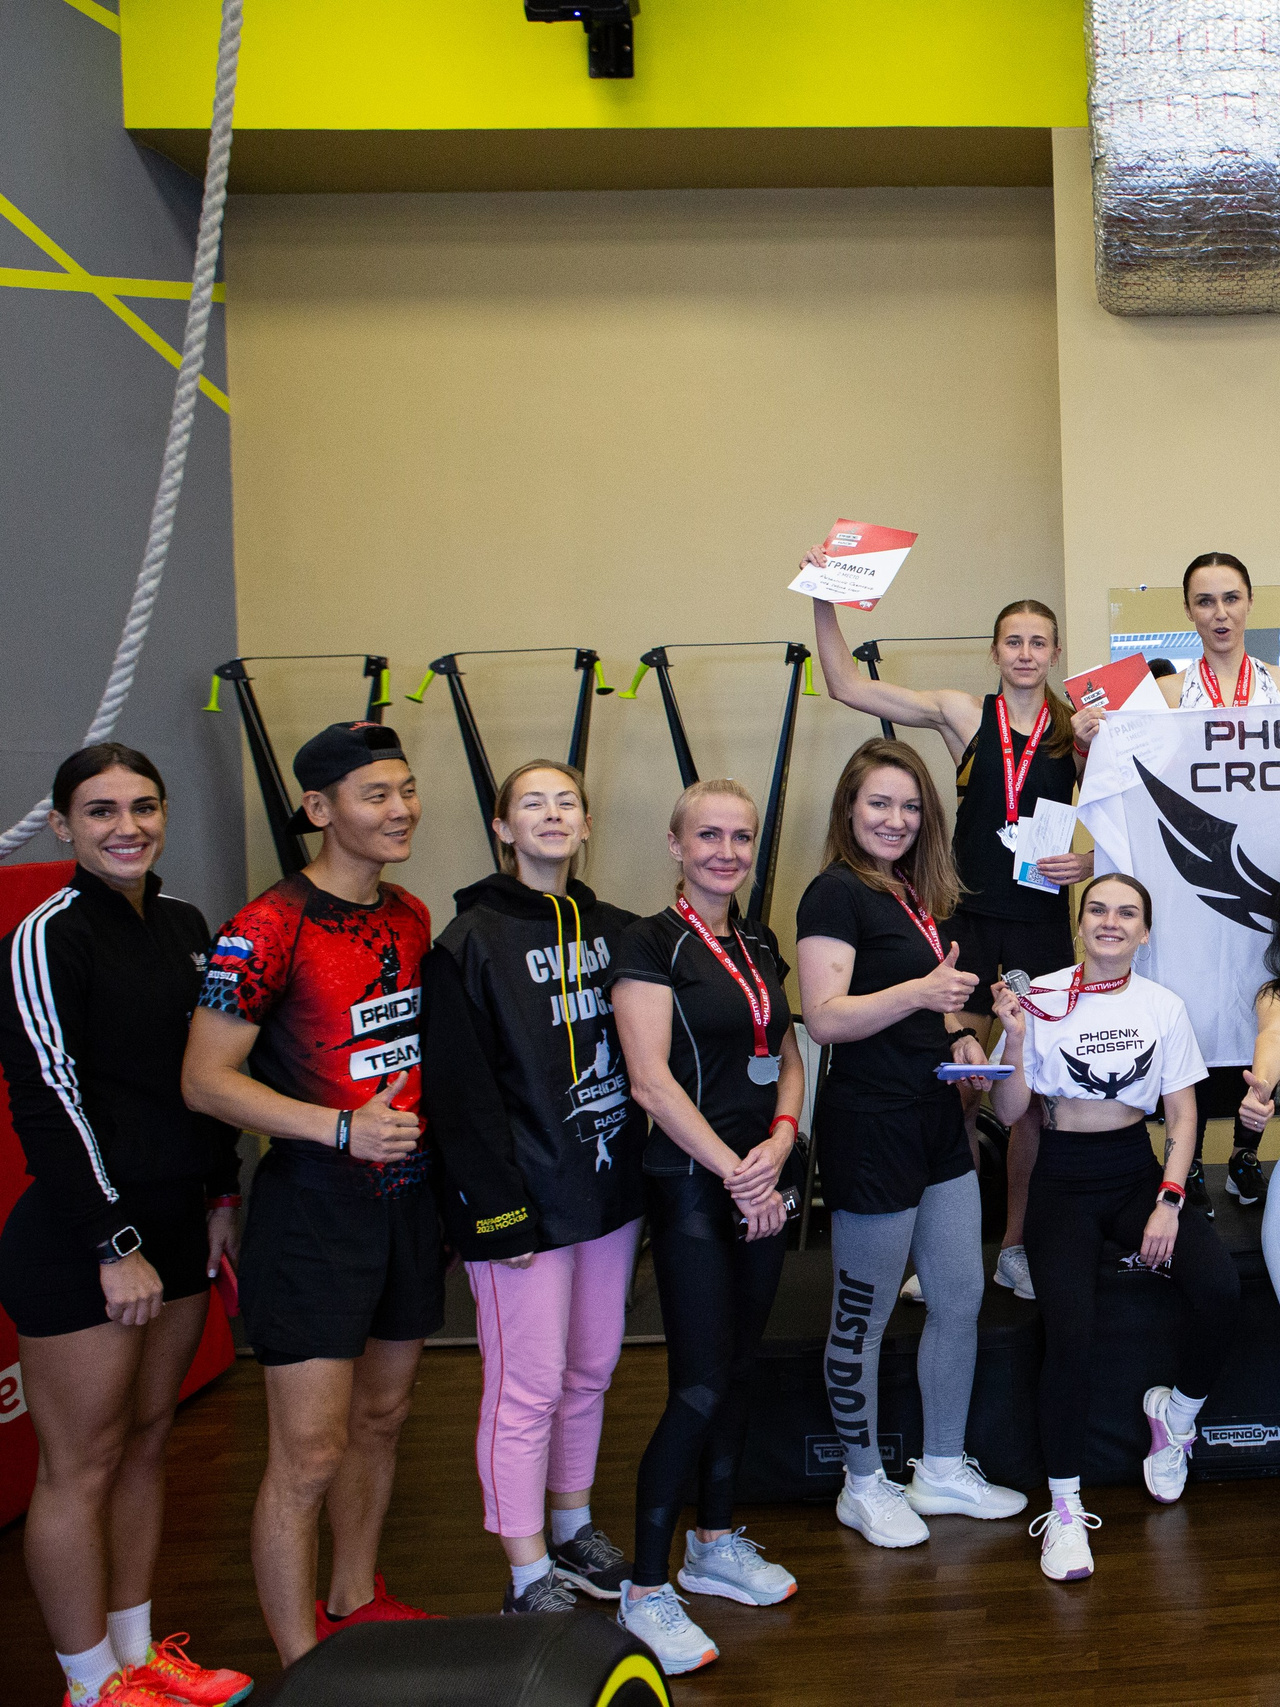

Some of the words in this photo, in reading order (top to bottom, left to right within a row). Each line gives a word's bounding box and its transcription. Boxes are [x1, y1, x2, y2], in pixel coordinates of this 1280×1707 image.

[828, 560, 876, 577] ГРАМОТА
[998, 700, 1010, 744] CHAMPIONSHIP
[1030, 707, 1048, 747] CHAMPIONSHIP
[1006, 758, 1015, 810] CHAMPIONSHIP
[688, 914, 723, 954] ФИНИШЕР
[526, 936, 611, 983] СУДЬЯ
[724, 957, 738, 974] OCR
[738, 977, 762, 1026] ФИНИШЕР
[1084, 979, 1124, 992] ФИНИШЕР
[550, 986, 613, 1027] JUDG
[1076, 1040, 1144, 1056] CROSSFIT
[1080, 1028, 1140, 1043] PHOENIX
[577, 1074, 626, 1103] PRIDE
[594, 1108, 628, 1130] RACE
[476, 1211, 515, 1227] МАРАФОН
[476, 1225, 495, 1234] 2023
[495, 1212, 528, 1230] МОСКВА
[830, 1268, 875, 1356] JUST
[826, 1357, 867, 1414] DO
